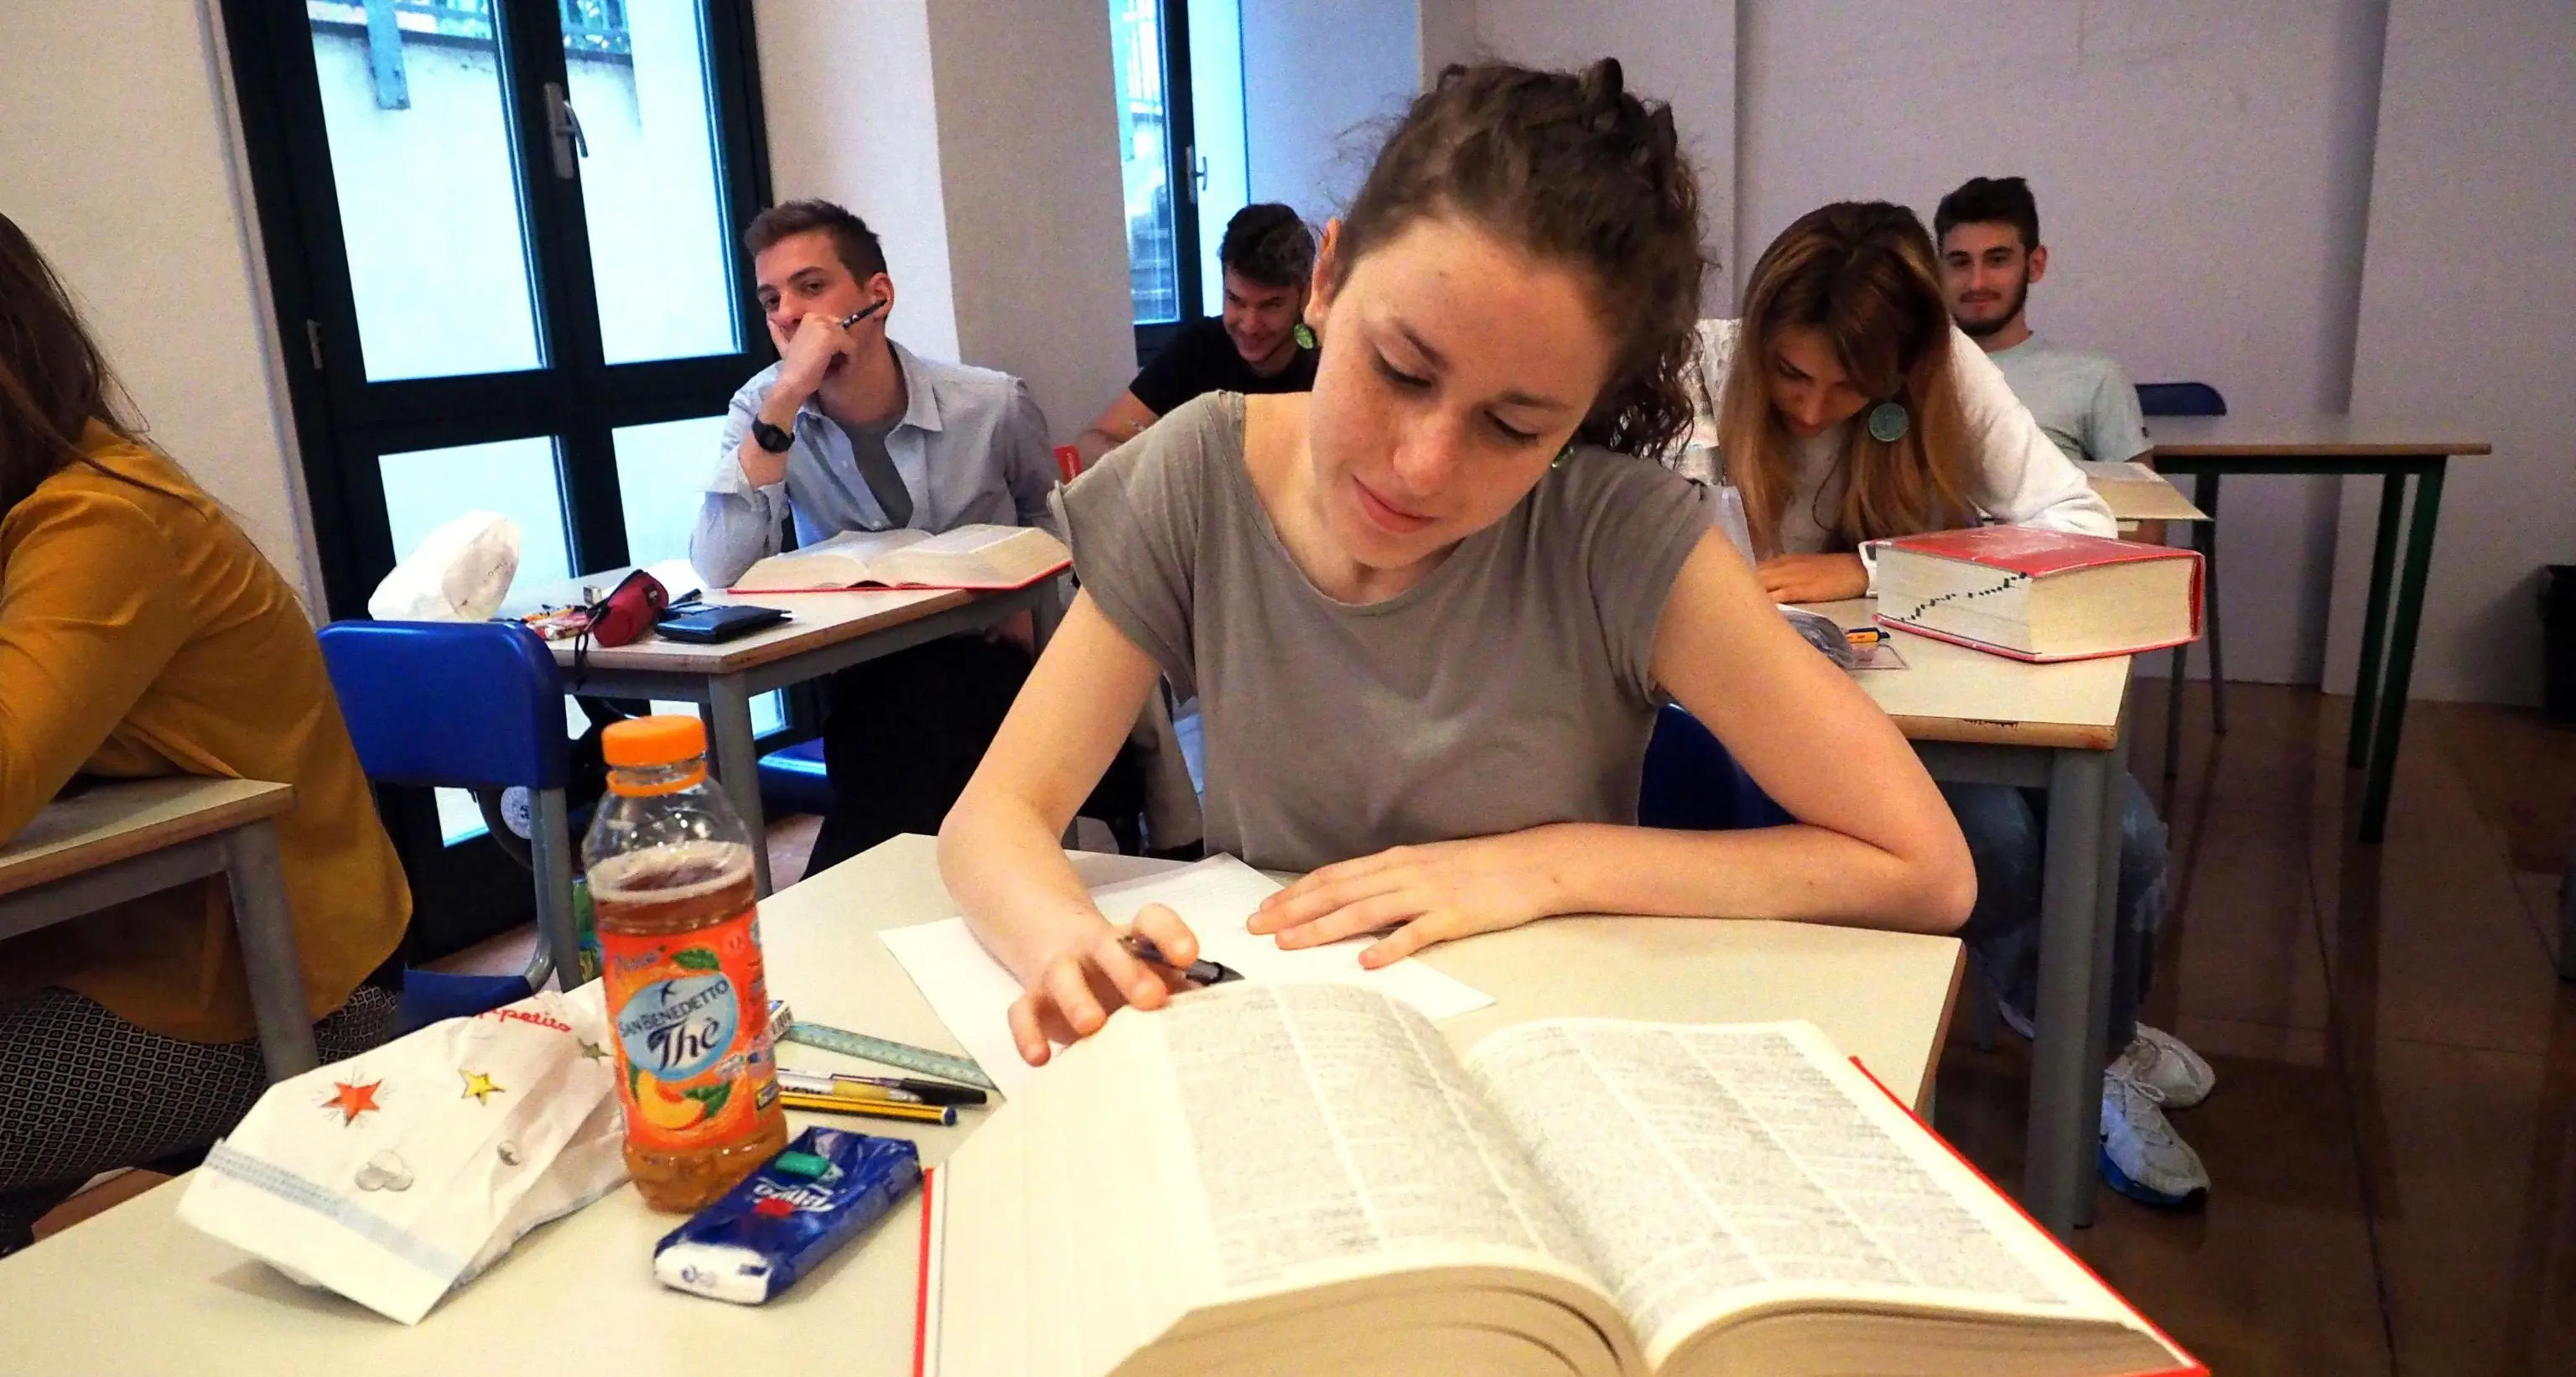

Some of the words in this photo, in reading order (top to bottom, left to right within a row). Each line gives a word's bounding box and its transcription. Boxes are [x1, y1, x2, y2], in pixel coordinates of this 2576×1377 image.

[477, 1007, 572, 1032] petito
[640, 979, 730, 1029] BENEDETTO
[647, 1016, 721, 1072] Thè
